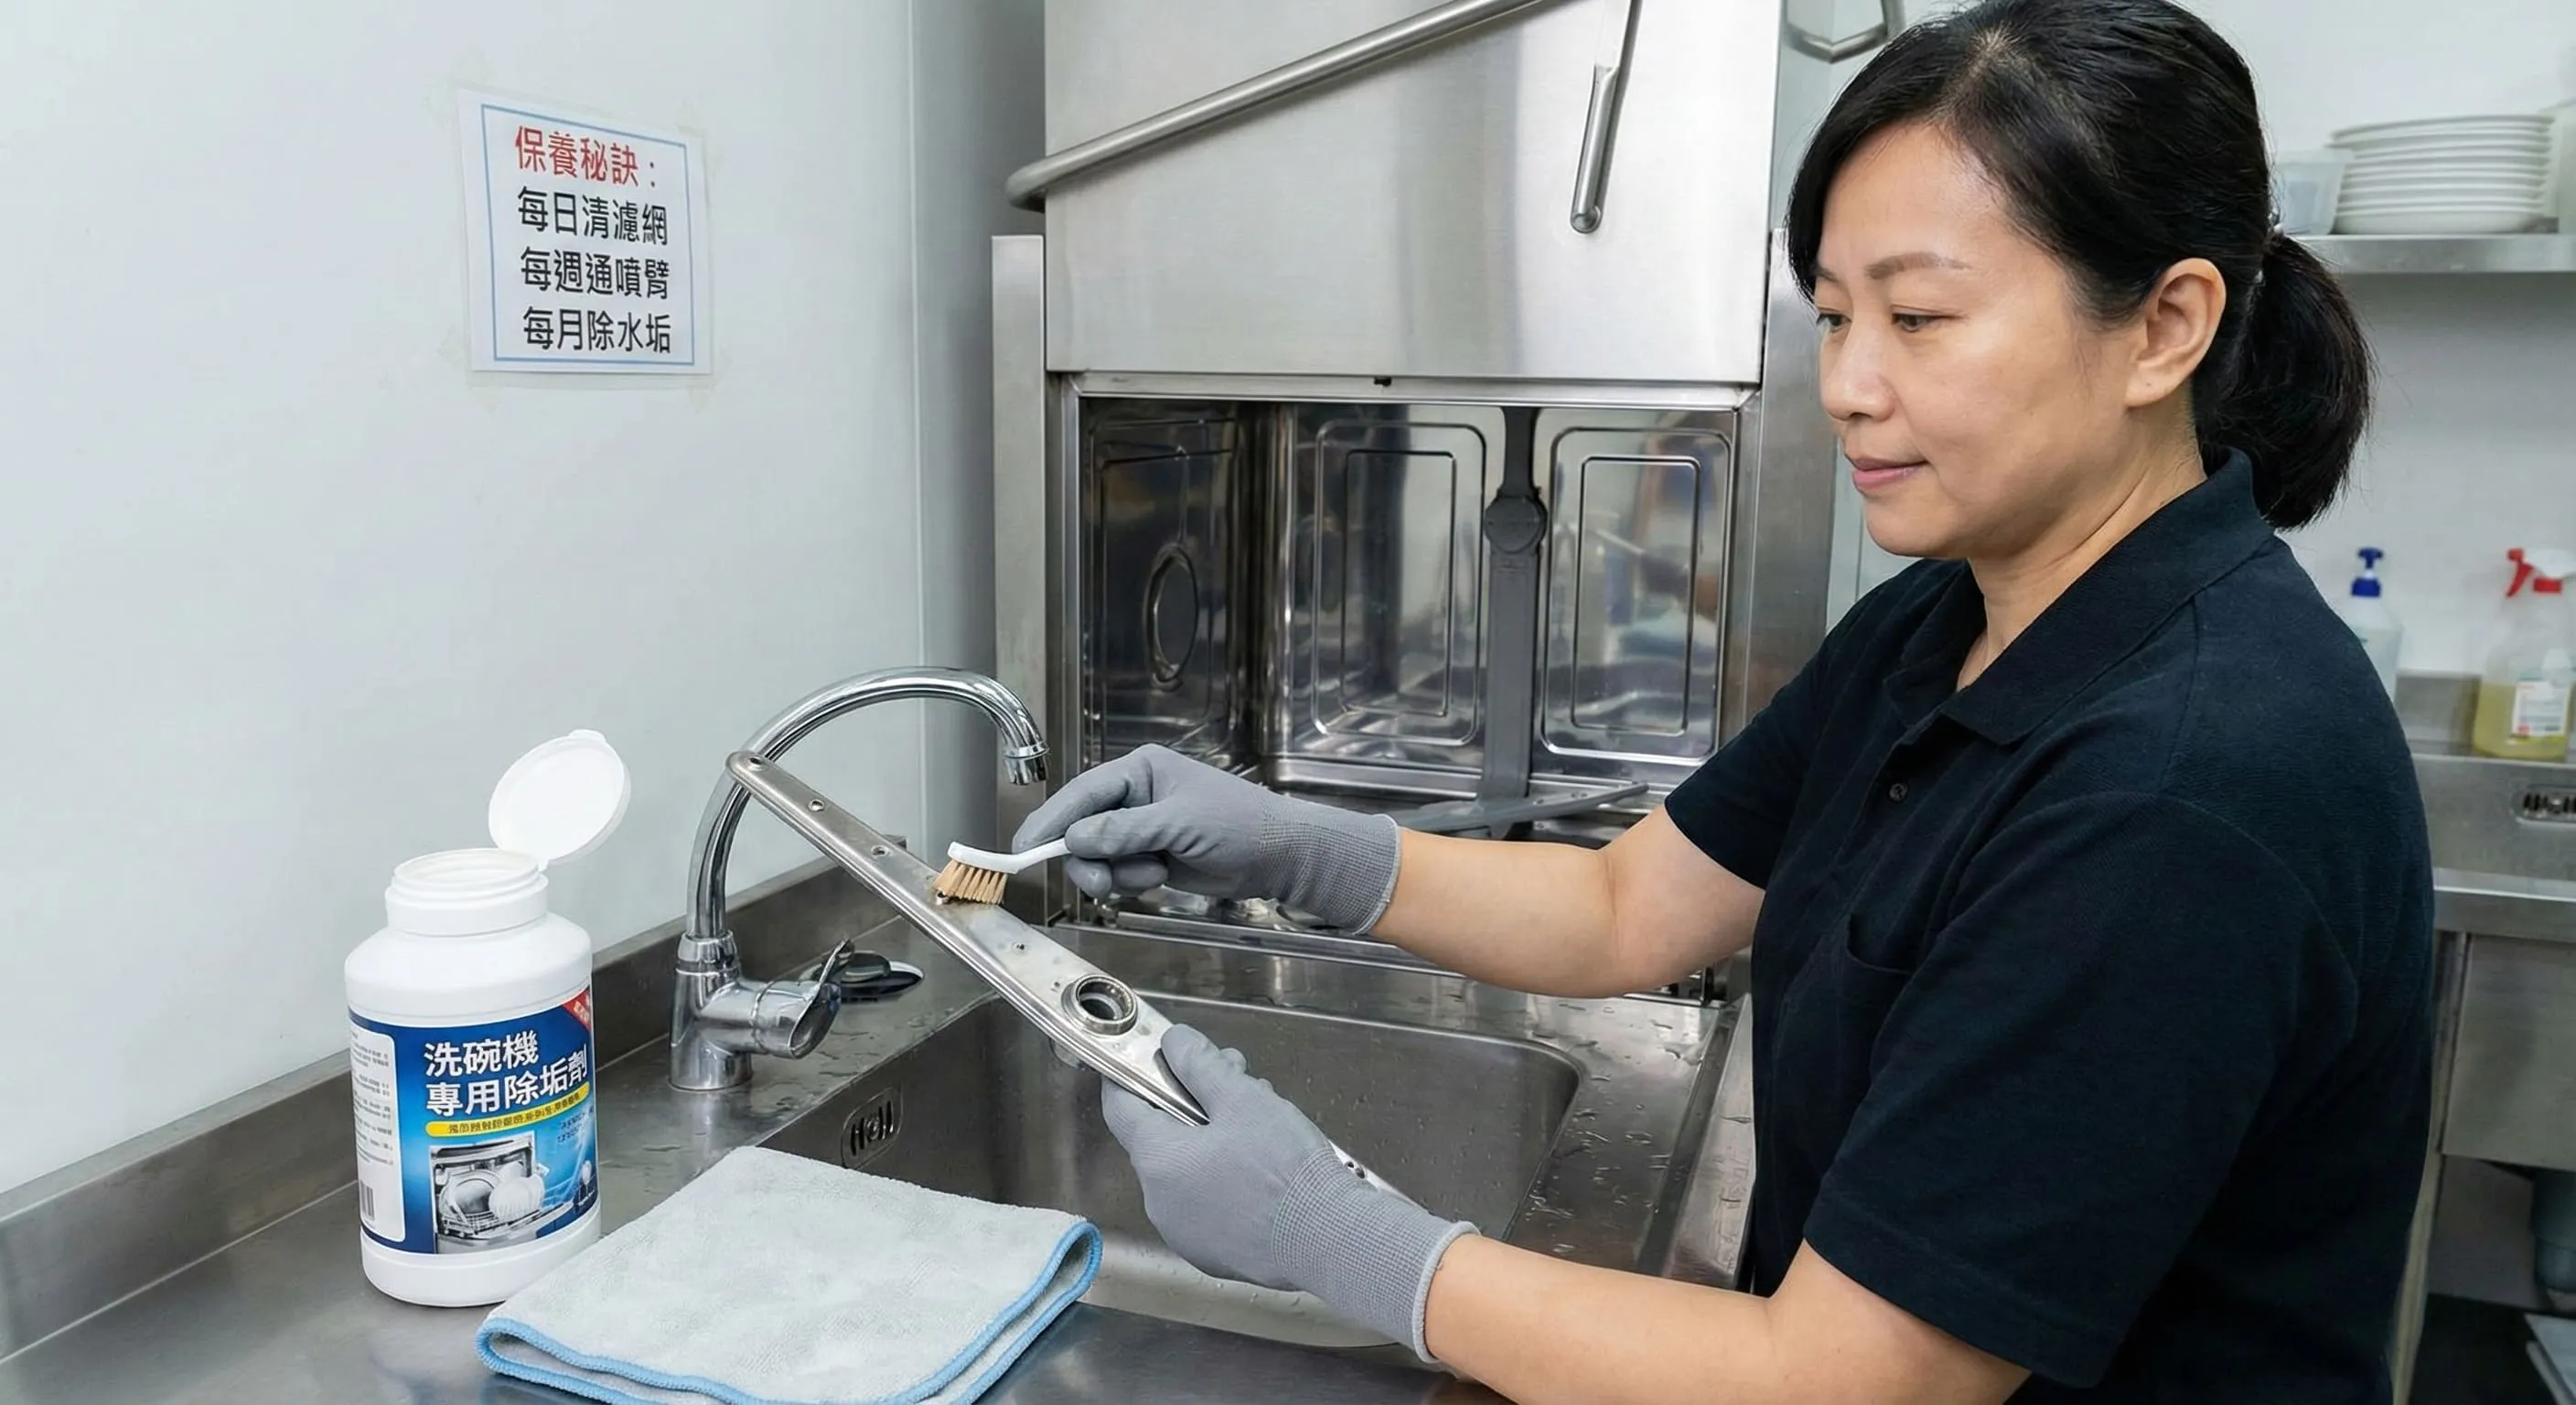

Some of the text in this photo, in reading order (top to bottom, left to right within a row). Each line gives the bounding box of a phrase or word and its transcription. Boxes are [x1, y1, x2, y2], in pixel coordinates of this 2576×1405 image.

[517, 186, 668, 246] 每日清濾網
[520, 246, 670, 300] 每週通噴臂
[522, 306, 671, 354] 每月除水垢
[424, 1030, 540, 1078] 洗碗機
[425, 1043, 588, 1117] 專用除垢劑
